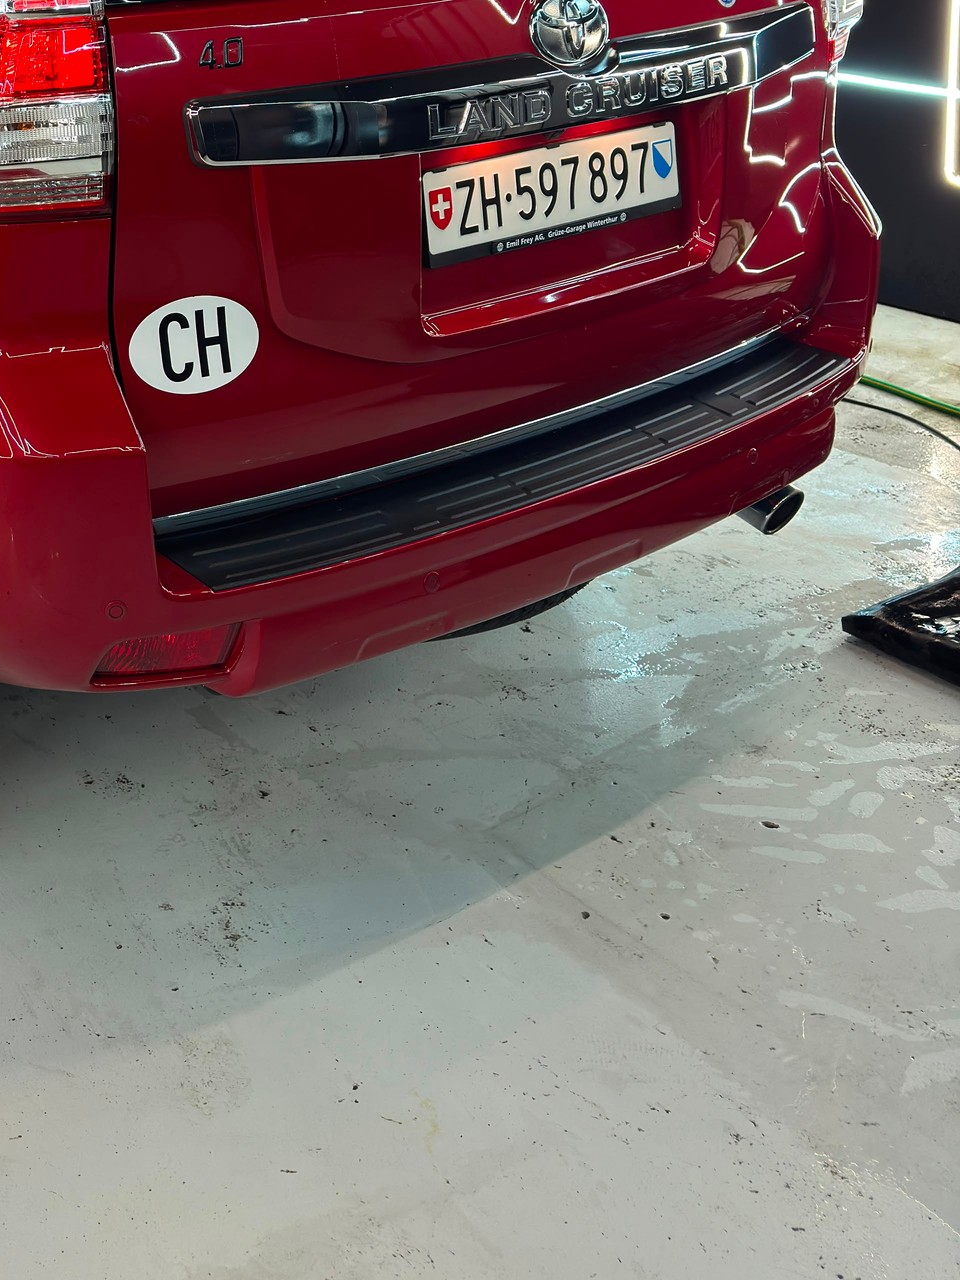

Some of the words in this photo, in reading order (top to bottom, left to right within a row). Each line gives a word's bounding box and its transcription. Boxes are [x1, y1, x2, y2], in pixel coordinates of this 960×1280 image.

[198, 36, 244, 70] 4.0
[426, 89, 552, 140] LAND
[565, 52, 729, 118] CRUISER
[506, 239, 520, 249] Emil
[520, 236, 534, 246] Frey
[534, 233, 546, 242] AG,
[547, 223, 587, 239] Grüze-Garage
[586, 216, 619, 229] Winterthur
[158, 305, 232, 383] CH
